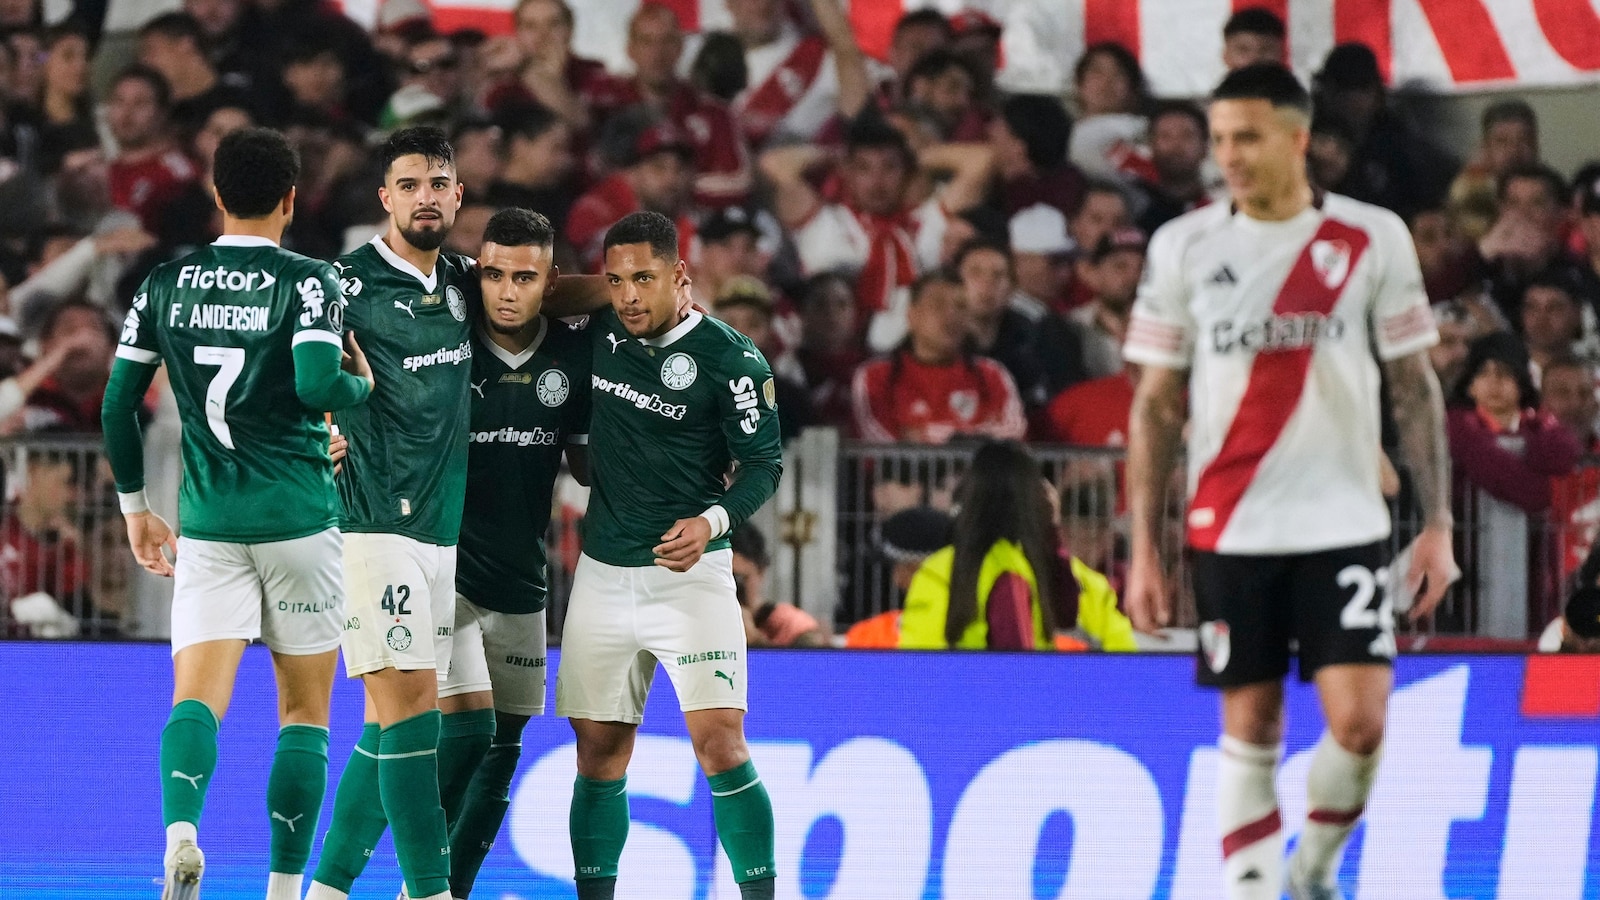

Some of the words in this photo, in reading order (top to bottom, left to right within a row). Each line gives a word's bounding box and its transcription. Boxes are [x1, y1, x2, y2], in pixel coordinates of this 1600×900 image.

[176, 265, 259, 292] Fictor
[169, 303, 185, 328] F.
[189, 303, 270, 331] ANDERSON
[193, 345, 246, 450] 7
[468, 426, 560, 447] portingbet
[381, 584, 412, 616] 42
[676, 650, 737, 666] UNIASSELVI
[580, 866, 601, 874] SEP
[746, 866, 767, 877] SEP
